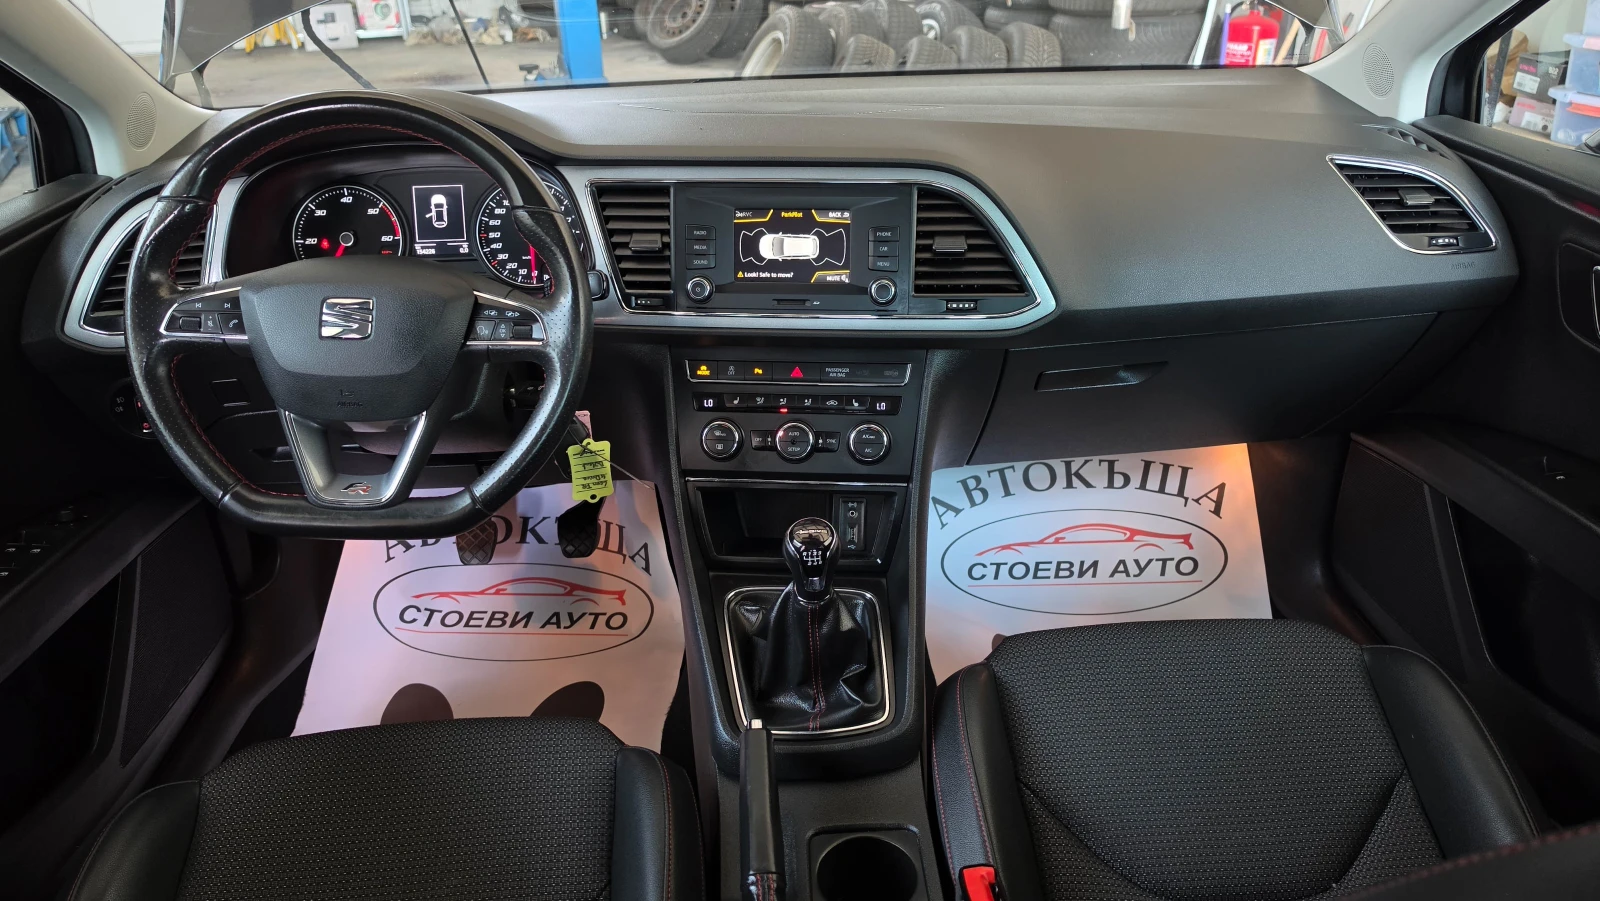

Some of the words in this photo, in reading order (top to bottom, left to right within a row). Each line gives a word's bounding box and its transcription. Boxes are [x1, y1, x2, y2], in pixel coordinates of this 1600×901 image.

[1451, 262, 1475, 270] AIRBAG
[930, 458, 1228, 530] АВТОКЪЩА
[967, 560, 1099, 581] СТОЕВИ
[1108, 556, 1199, 578] АУТО
[398, 604, 534, 629] СТОЕВИ
[540, 611, 629, 630] АУТО
